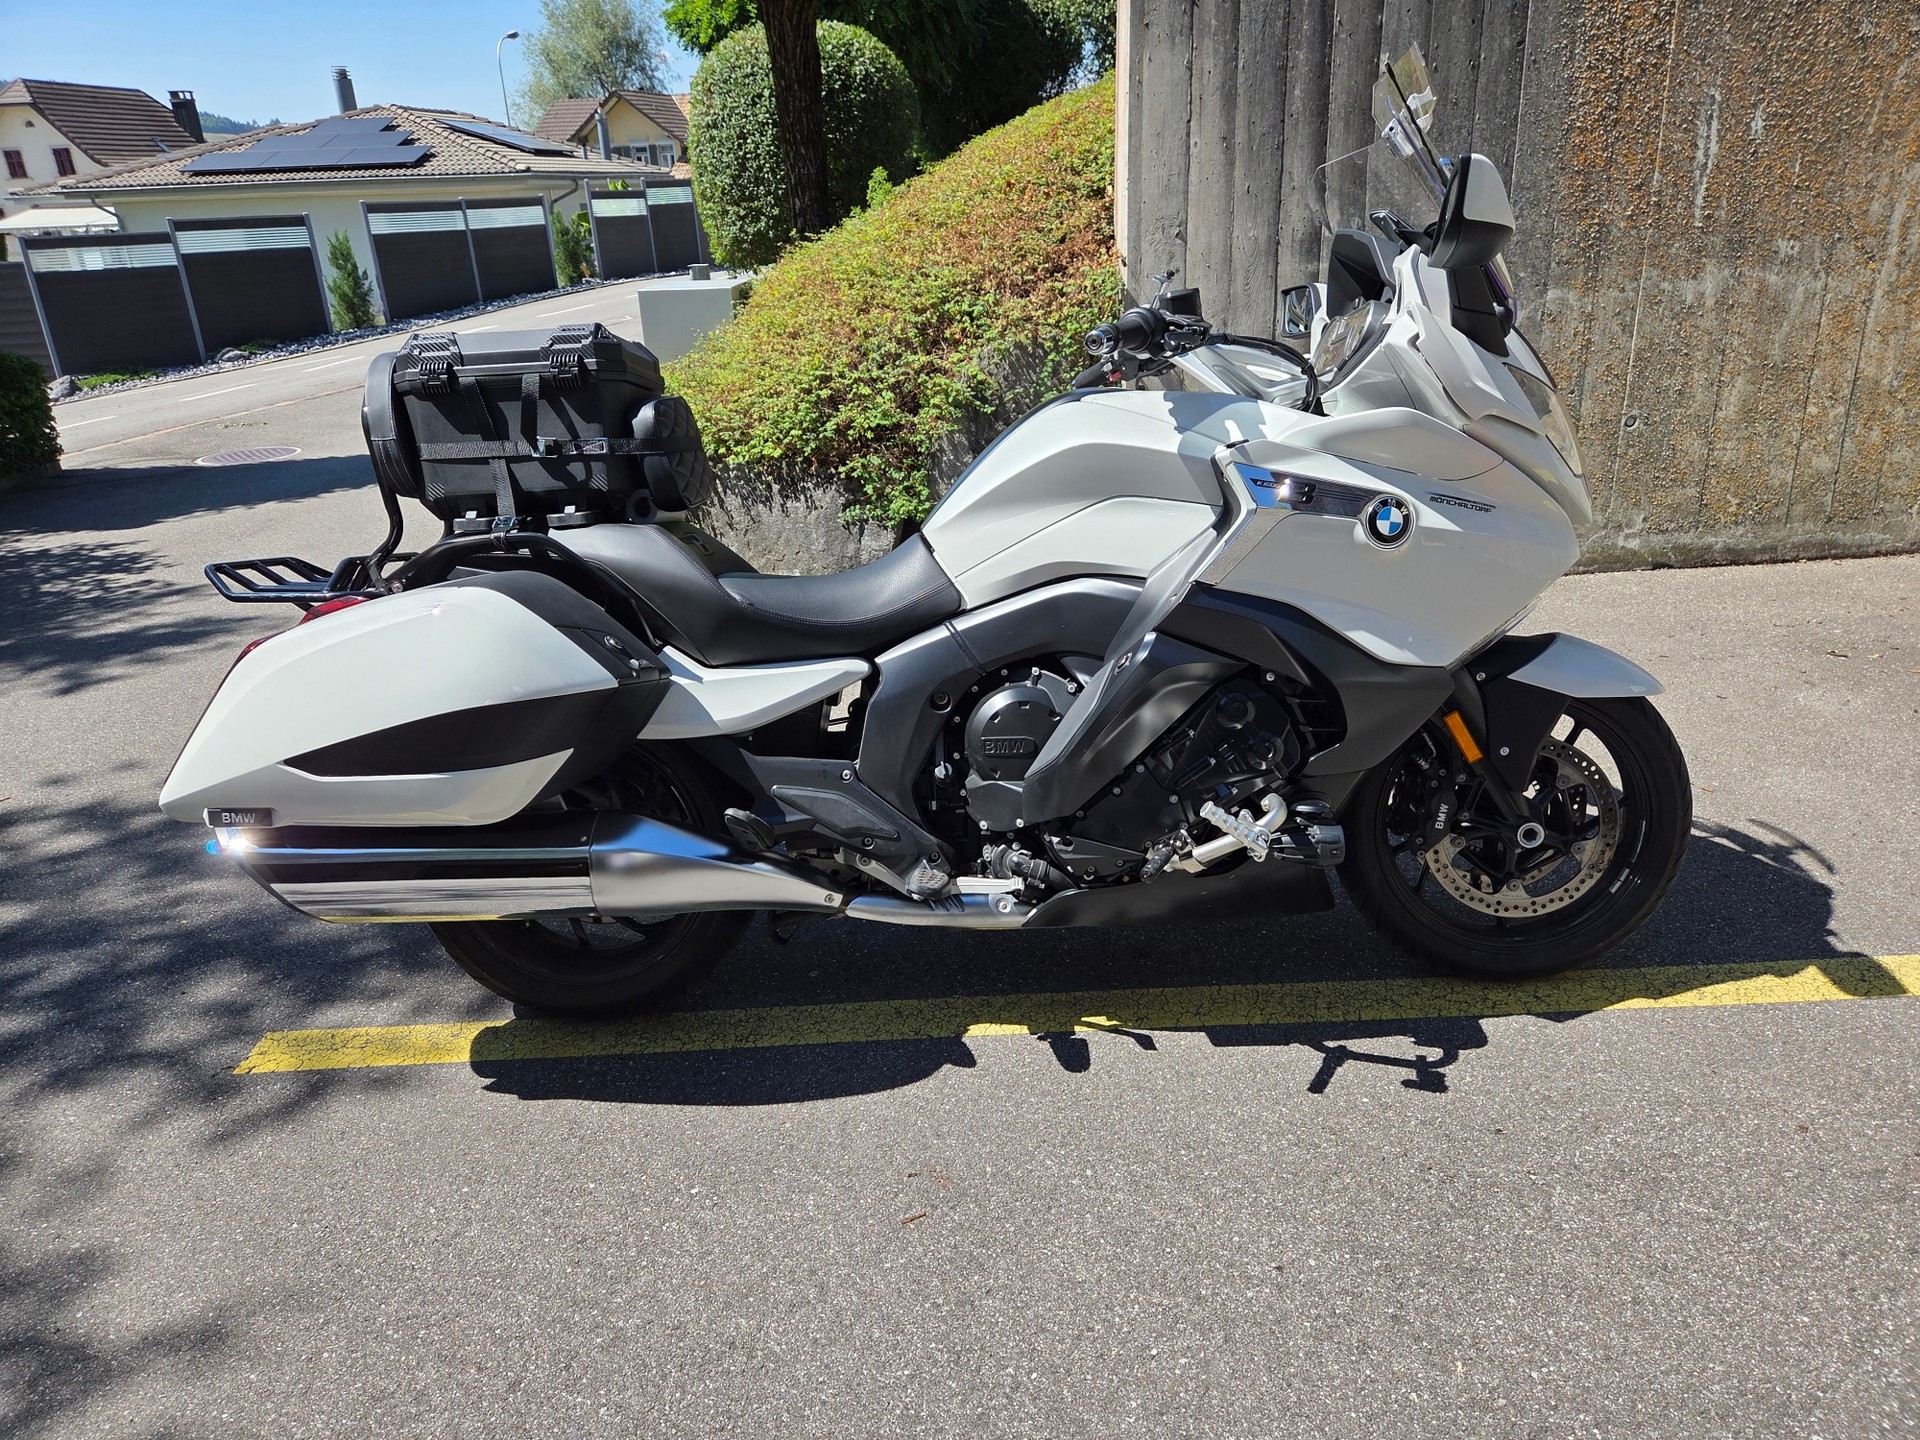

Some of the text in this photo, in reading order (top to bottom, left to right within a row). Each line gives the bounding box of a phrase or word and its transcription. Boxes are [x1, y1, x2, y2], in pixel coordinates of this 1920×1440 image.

[1374, 499, 1408, 515] BMW
[984, 741, 1025, 754] BMW
[222, 813, 255, 823] BMW
[1435, 803, 1449, 829] BMW
